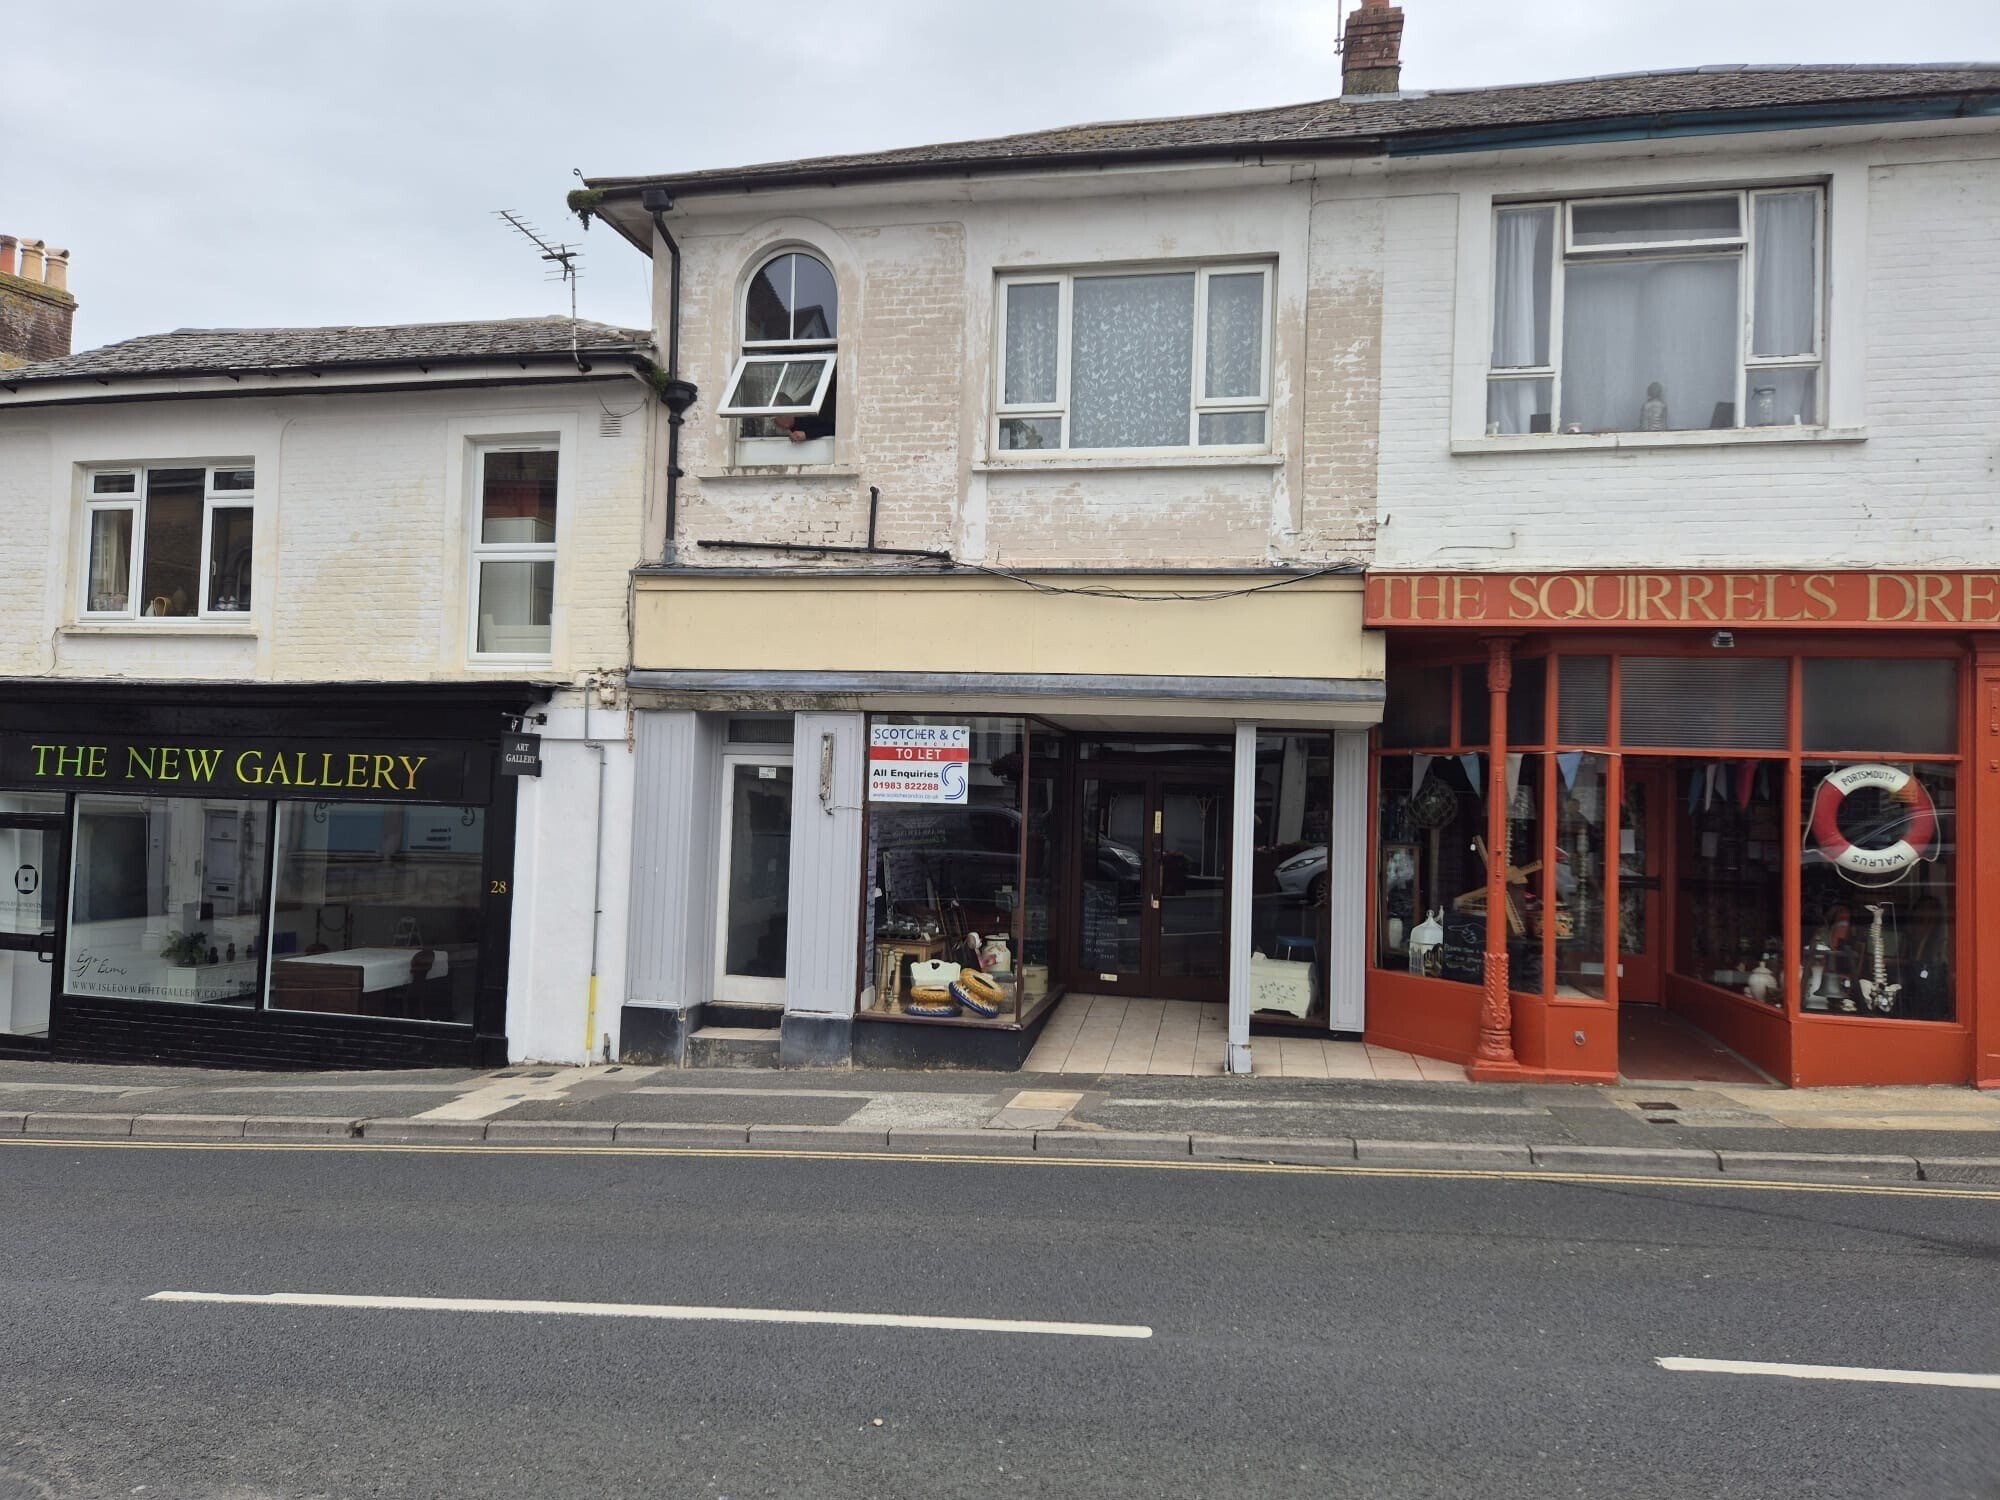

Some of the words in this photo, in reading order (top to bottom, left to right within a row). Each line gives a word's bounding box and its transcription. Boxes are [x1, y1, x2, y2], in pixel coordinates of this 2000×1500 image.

[1369, 574, 1488, 621] THE
[1507, 574, 1838, 621] SQUIRREL'S
[874, 728, 936, 740] SCOTCHER
[939, 729, 949, 740] &
[515, 743, 530, 752] ART
[505, 753, 537, 764] GALLERY
[896, 748, 913, 760] TO
[918, 748, 942, 760] LET
[31, 744, 109, 778] THE
[125, 746, 225, 784] NEW
[235, 750, 428, 791] GALLERY
[873, 768, 887, 777] All
[890, 769, 939, 779] Enquiries
[1841, 770, 1897, 786] PORTSMOUTH
[873, 781, 902, 790] 01983
[904, 782, 939, 791] 822288
[1851, 854, 1905, 867] WALRUS
[490, 880, 507, 894] 28
